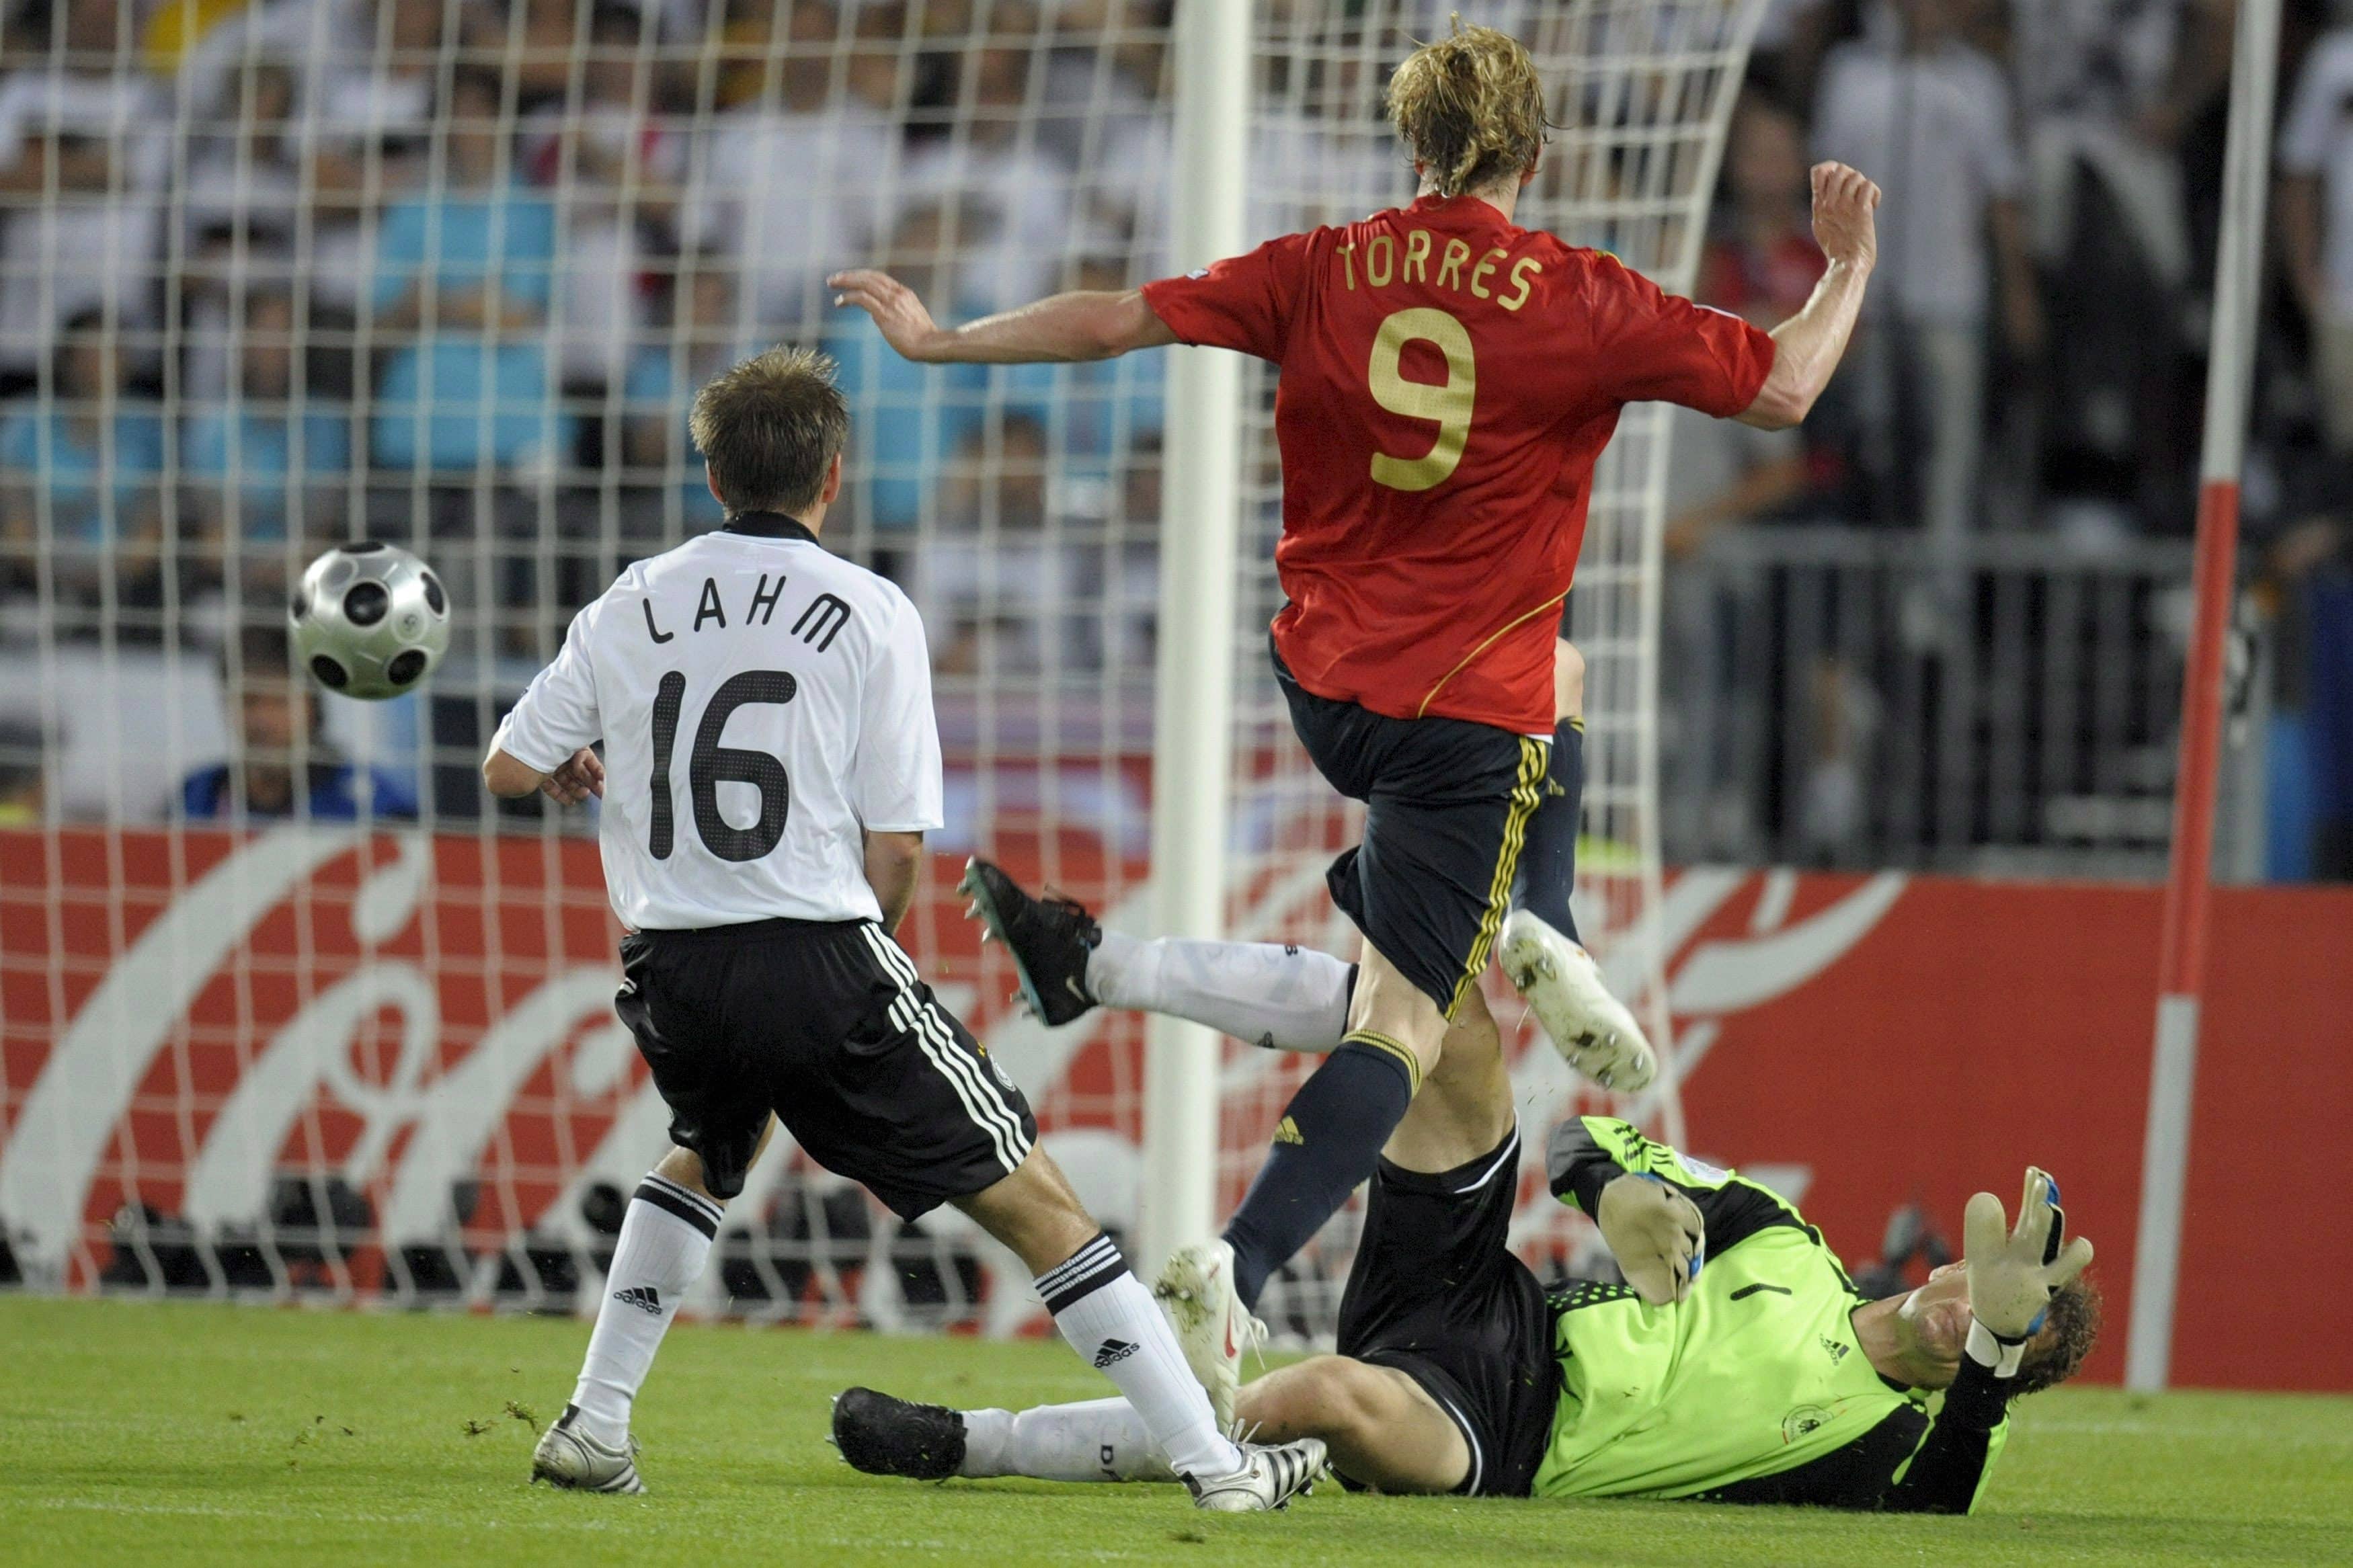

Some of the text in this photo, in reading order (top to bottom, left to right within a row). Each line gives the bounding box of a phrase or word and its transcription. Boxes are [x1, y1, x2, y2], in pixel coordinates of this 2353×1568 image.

[1336, 230, 1542, 311] TORRES
[1369, 307, 1476, 491] 9
[643, 573, 851, 653] LAHM
[649, 669, 797, 863] 16
[613, 1289, 663, 1315] adidas
[1094, 1342, 1141, 1368] adidas
